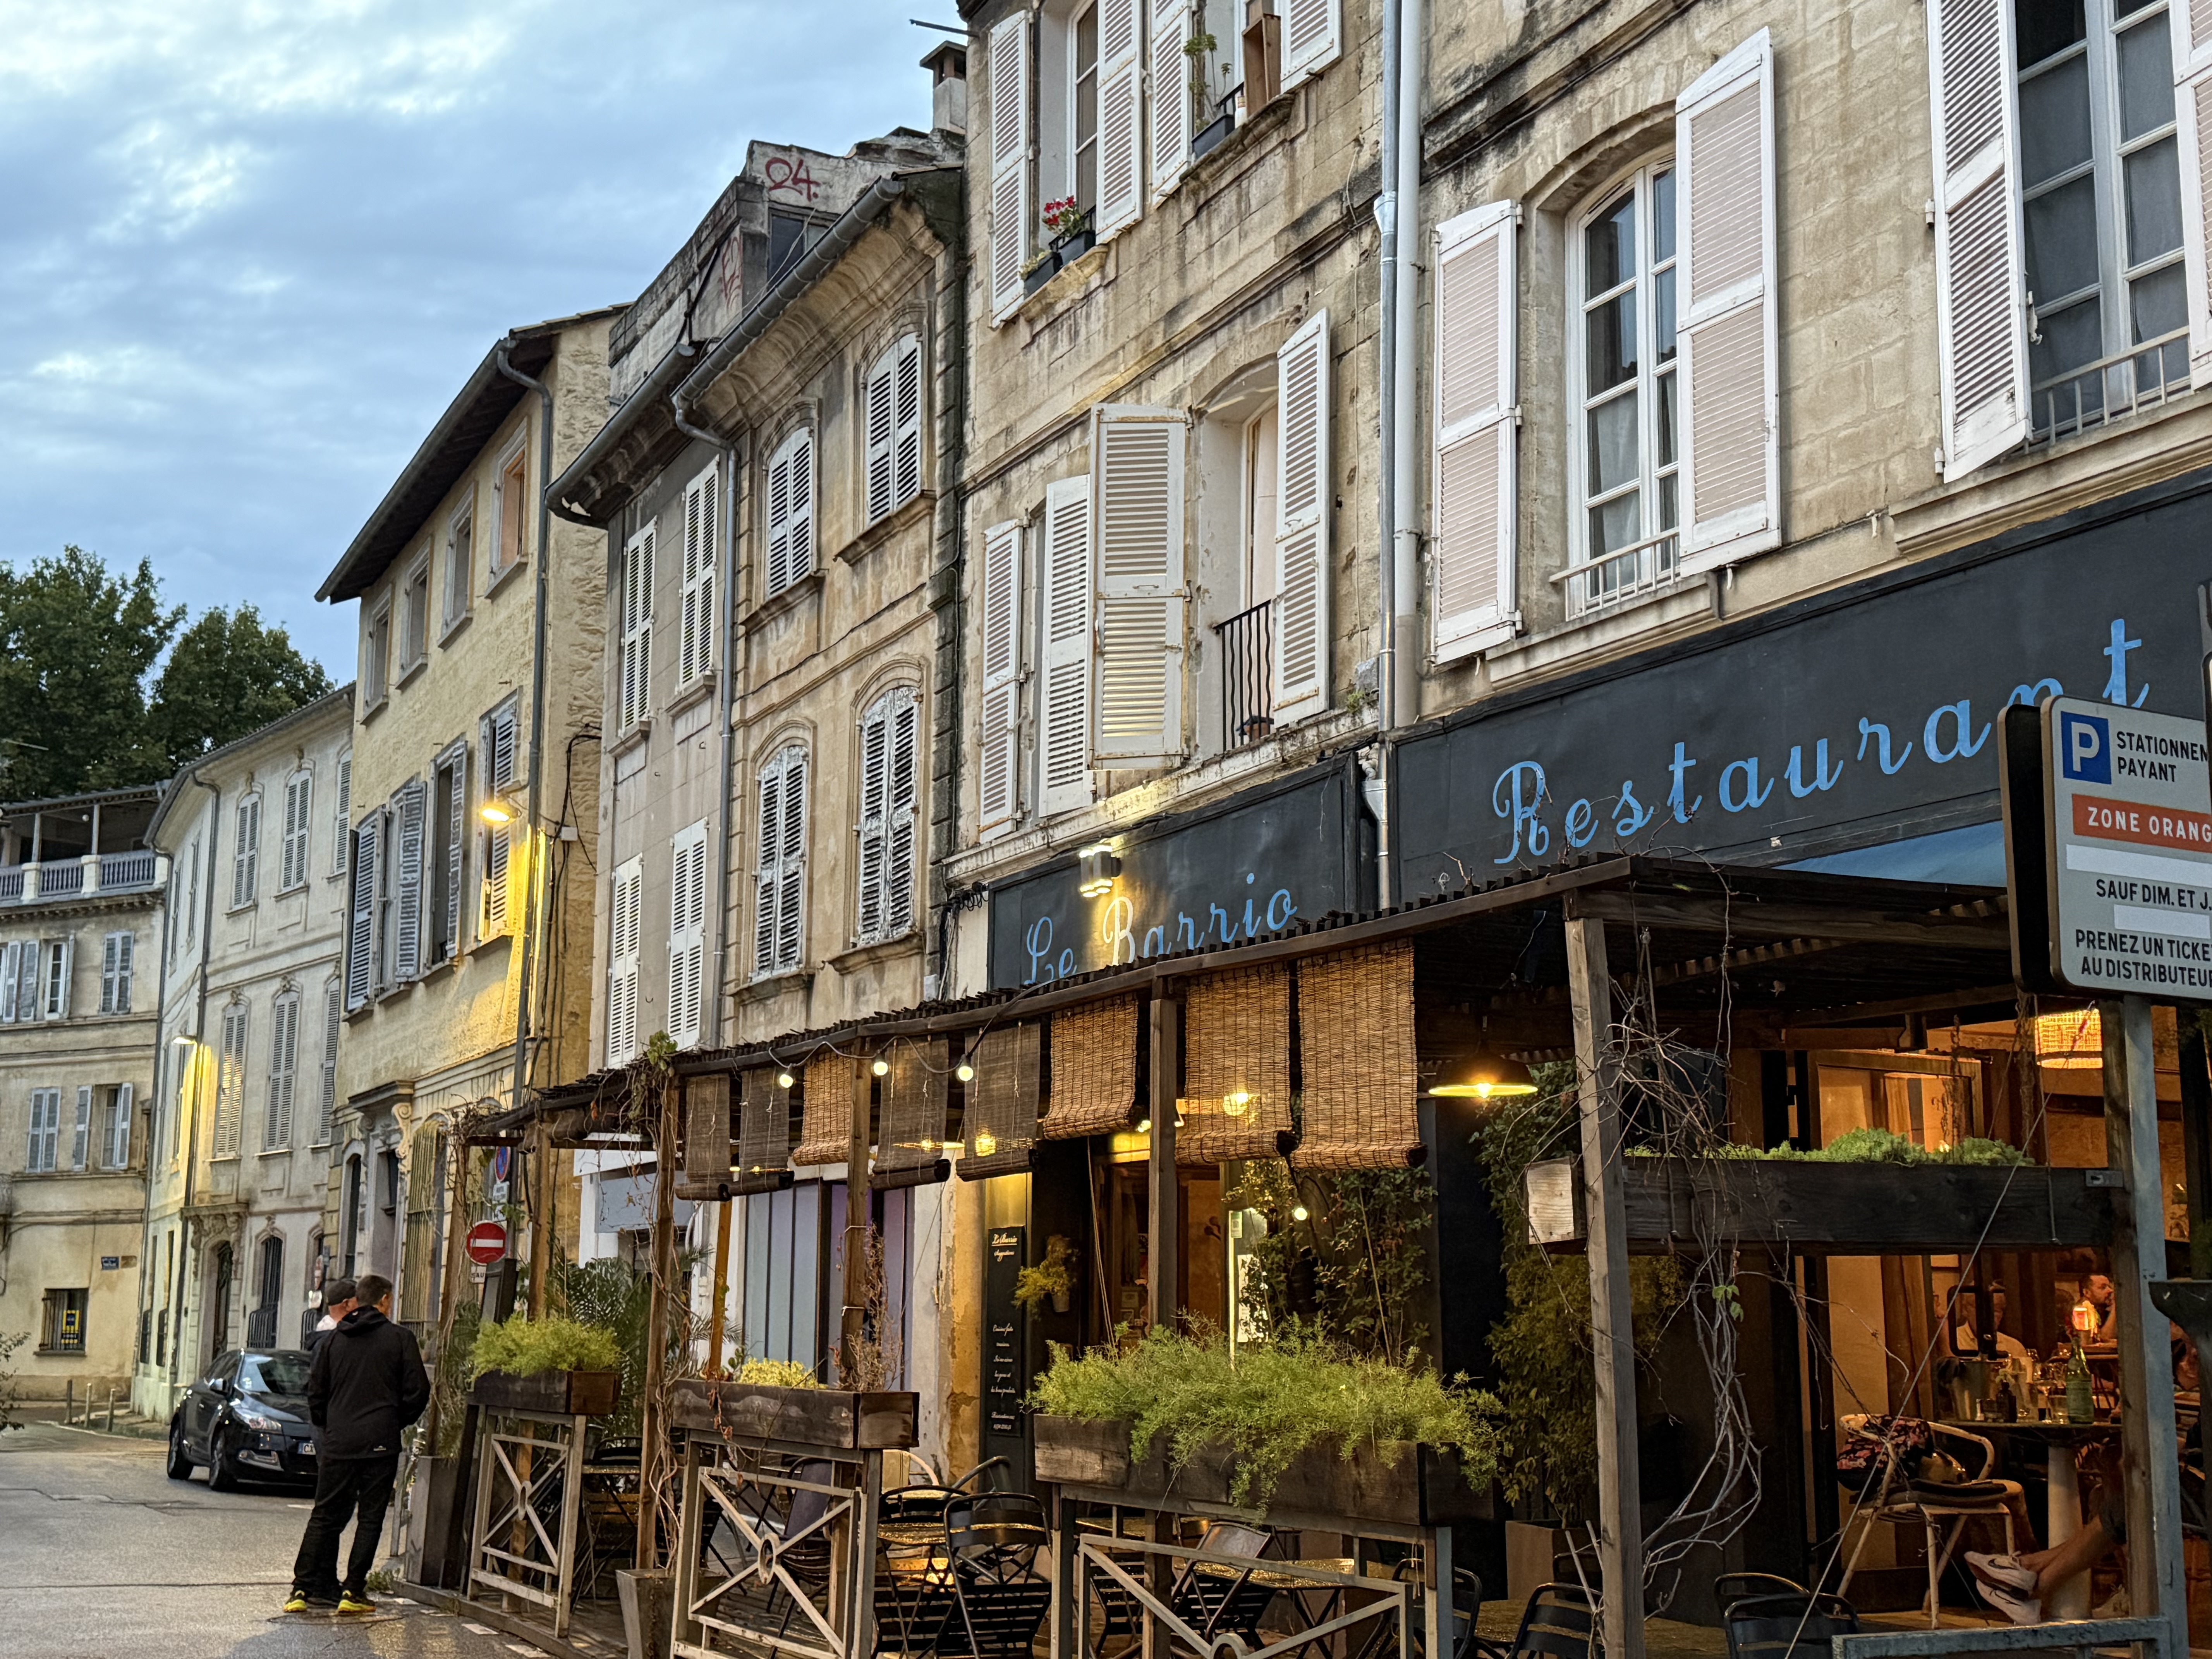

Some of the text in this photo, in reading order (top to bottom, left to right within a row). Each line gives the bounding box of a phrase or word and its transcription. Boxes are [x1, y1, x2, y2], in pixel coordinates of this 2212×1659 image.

[2071, 722, 2100, 772] P
[2117, 756, 2176, 782] PAYANT
[2088, 807, 2212, 843] ZONE ORANG
[2096, 879, 2138, 901] SAUF
[2142, 884, 2174, 906] DIM.
[2178, 889, 2195, 908] ET
[1024, 872, 1297, 985] Le Barrio
[2075, 929, 2212, 962] PRENEZ UN TICKE
[2081, 956, 2102, 975] AU
